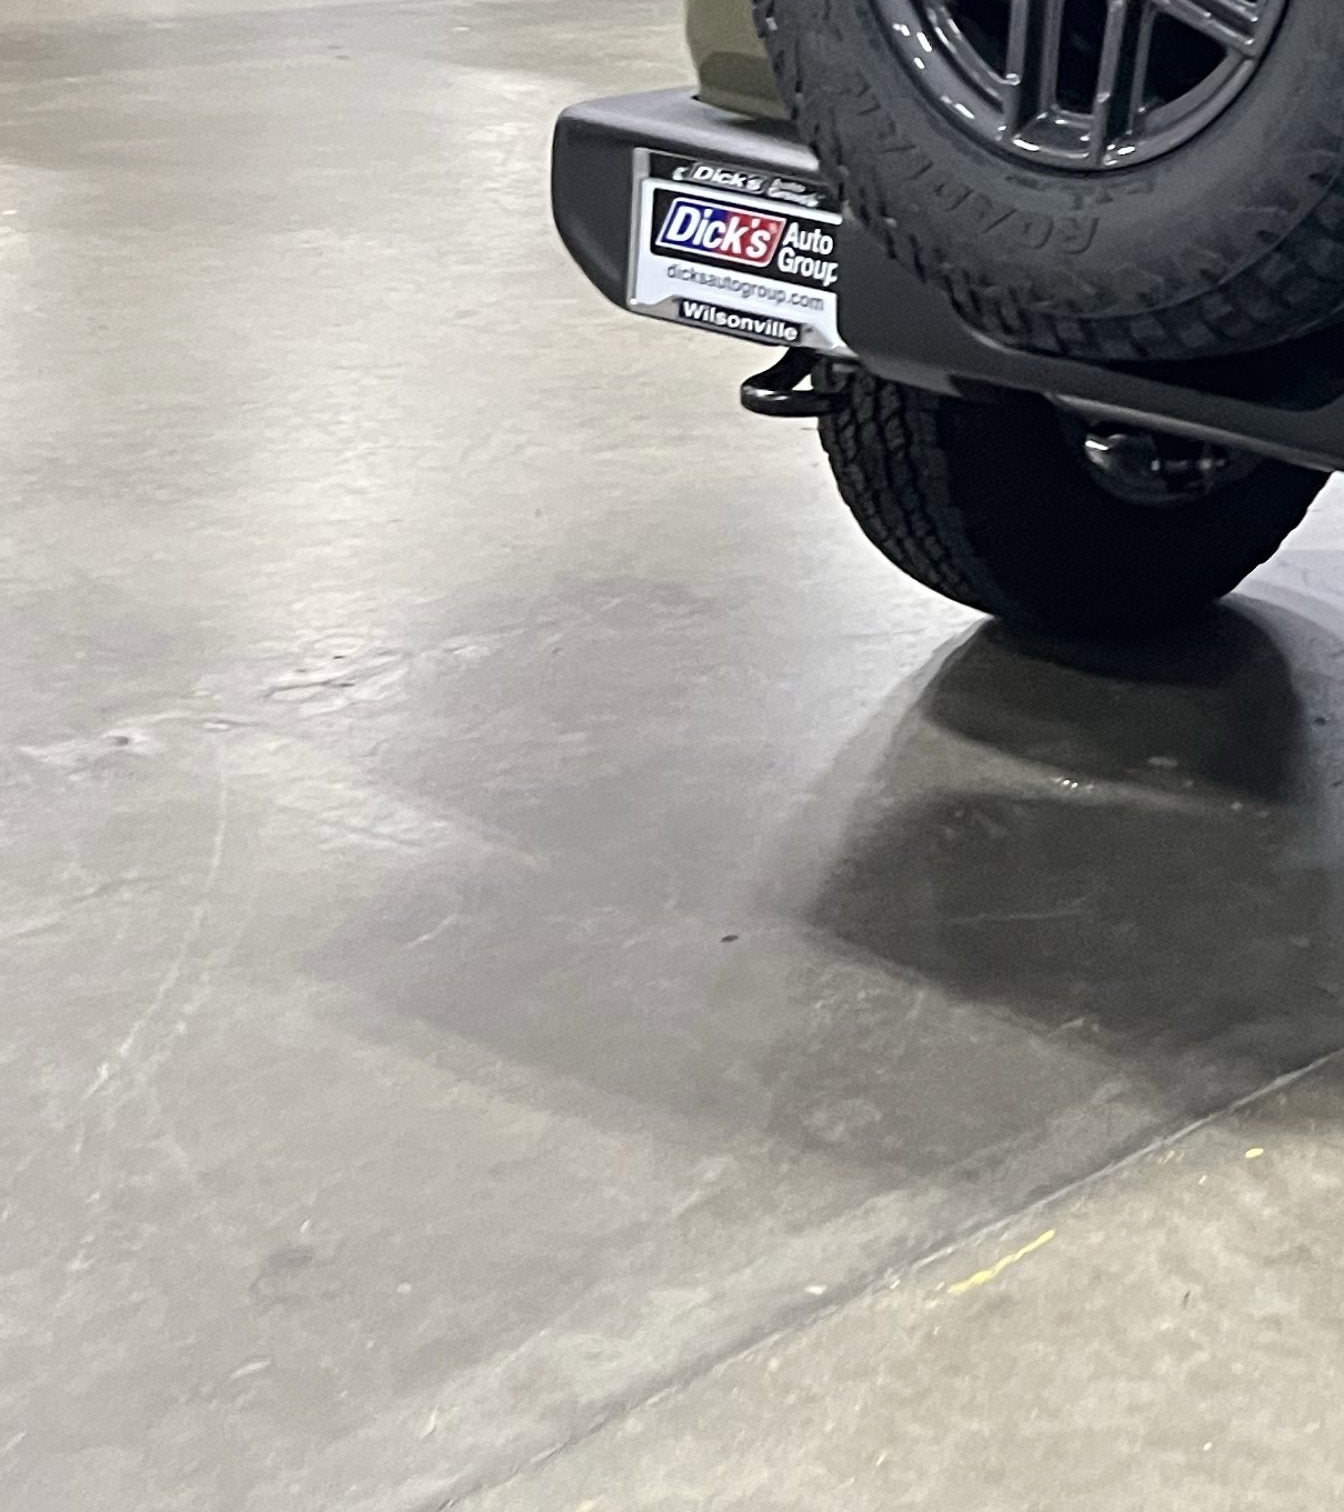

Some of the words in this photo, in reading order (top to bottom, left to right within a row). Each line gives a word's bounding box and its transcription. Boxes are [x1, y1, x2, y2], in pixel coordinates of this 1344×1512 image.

[665, 205, 771, 259] Dick's
[782, 221, 833, 255] Auto
[666, 263, 825, 312] dicksautogroup.com
[683, 300, 798, 341] Wilsonville
